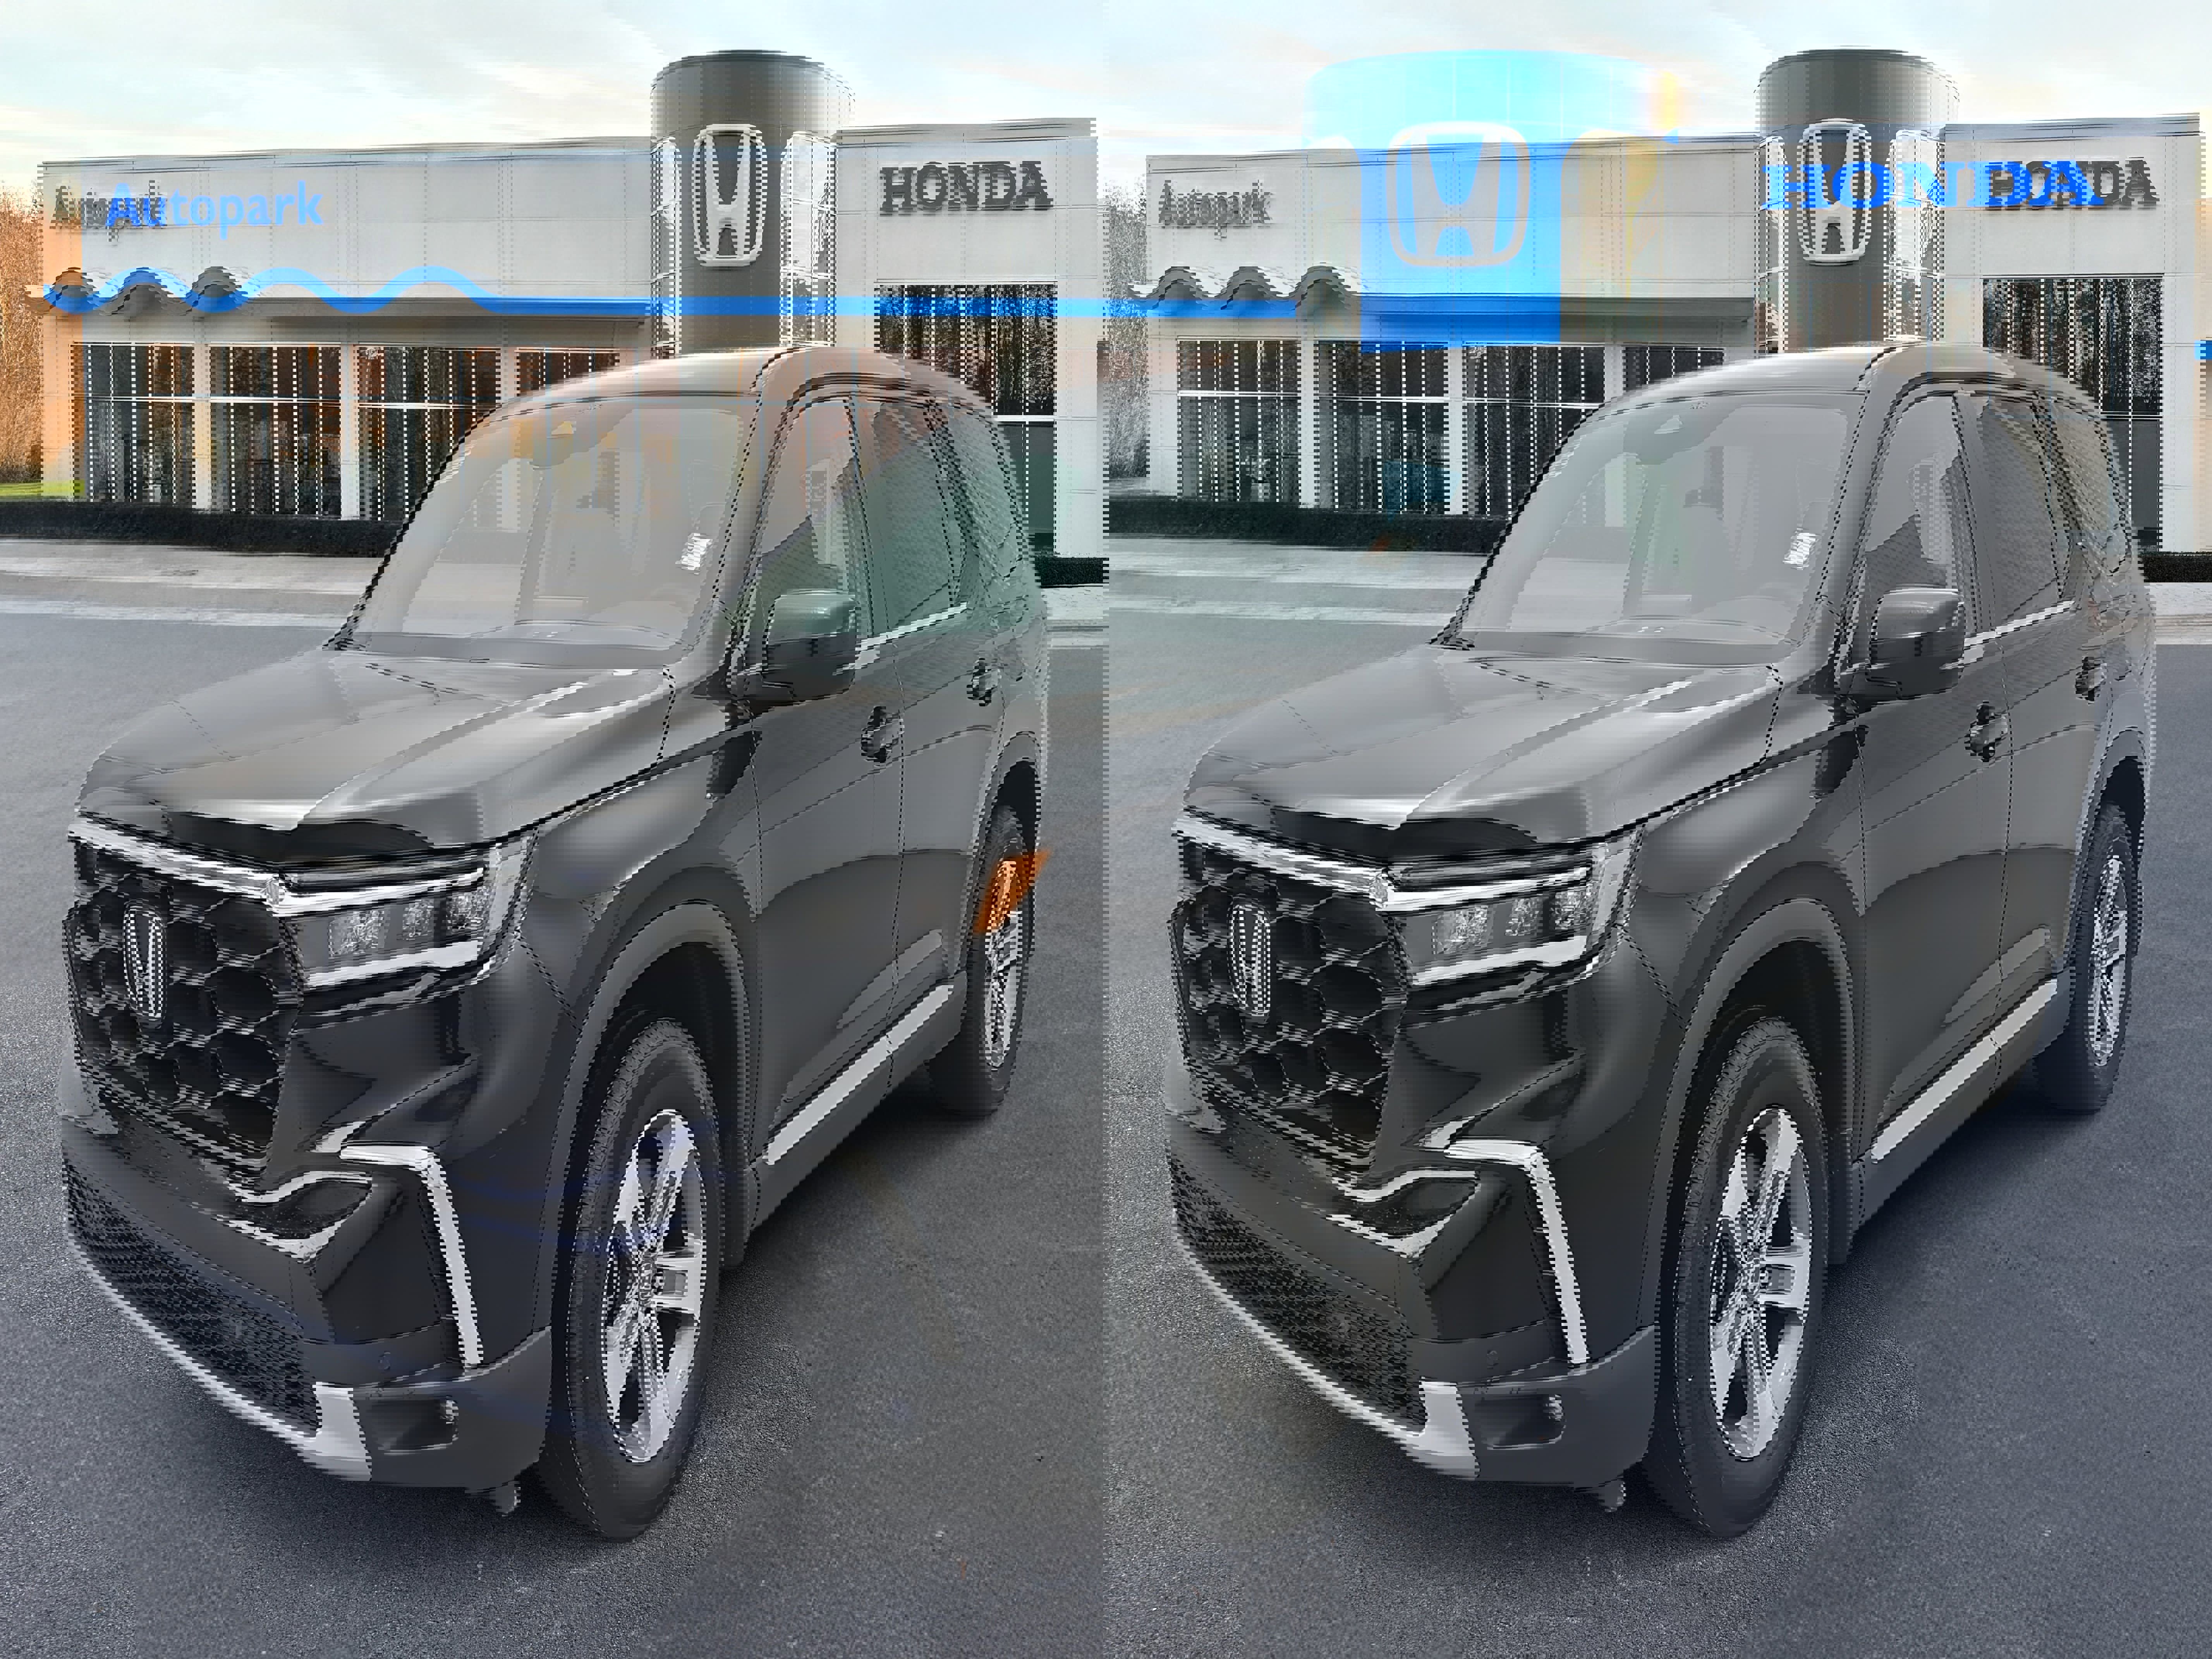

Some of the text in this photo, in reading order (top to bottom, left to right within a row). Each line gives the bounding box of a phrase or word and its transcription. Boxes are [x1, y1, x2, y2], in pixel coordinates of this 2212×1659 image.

[105, 180, 325, 240] Autopark
[880, 161, 1053, 211] HONDA
[1762, 160, 2106, 210] HONDA
